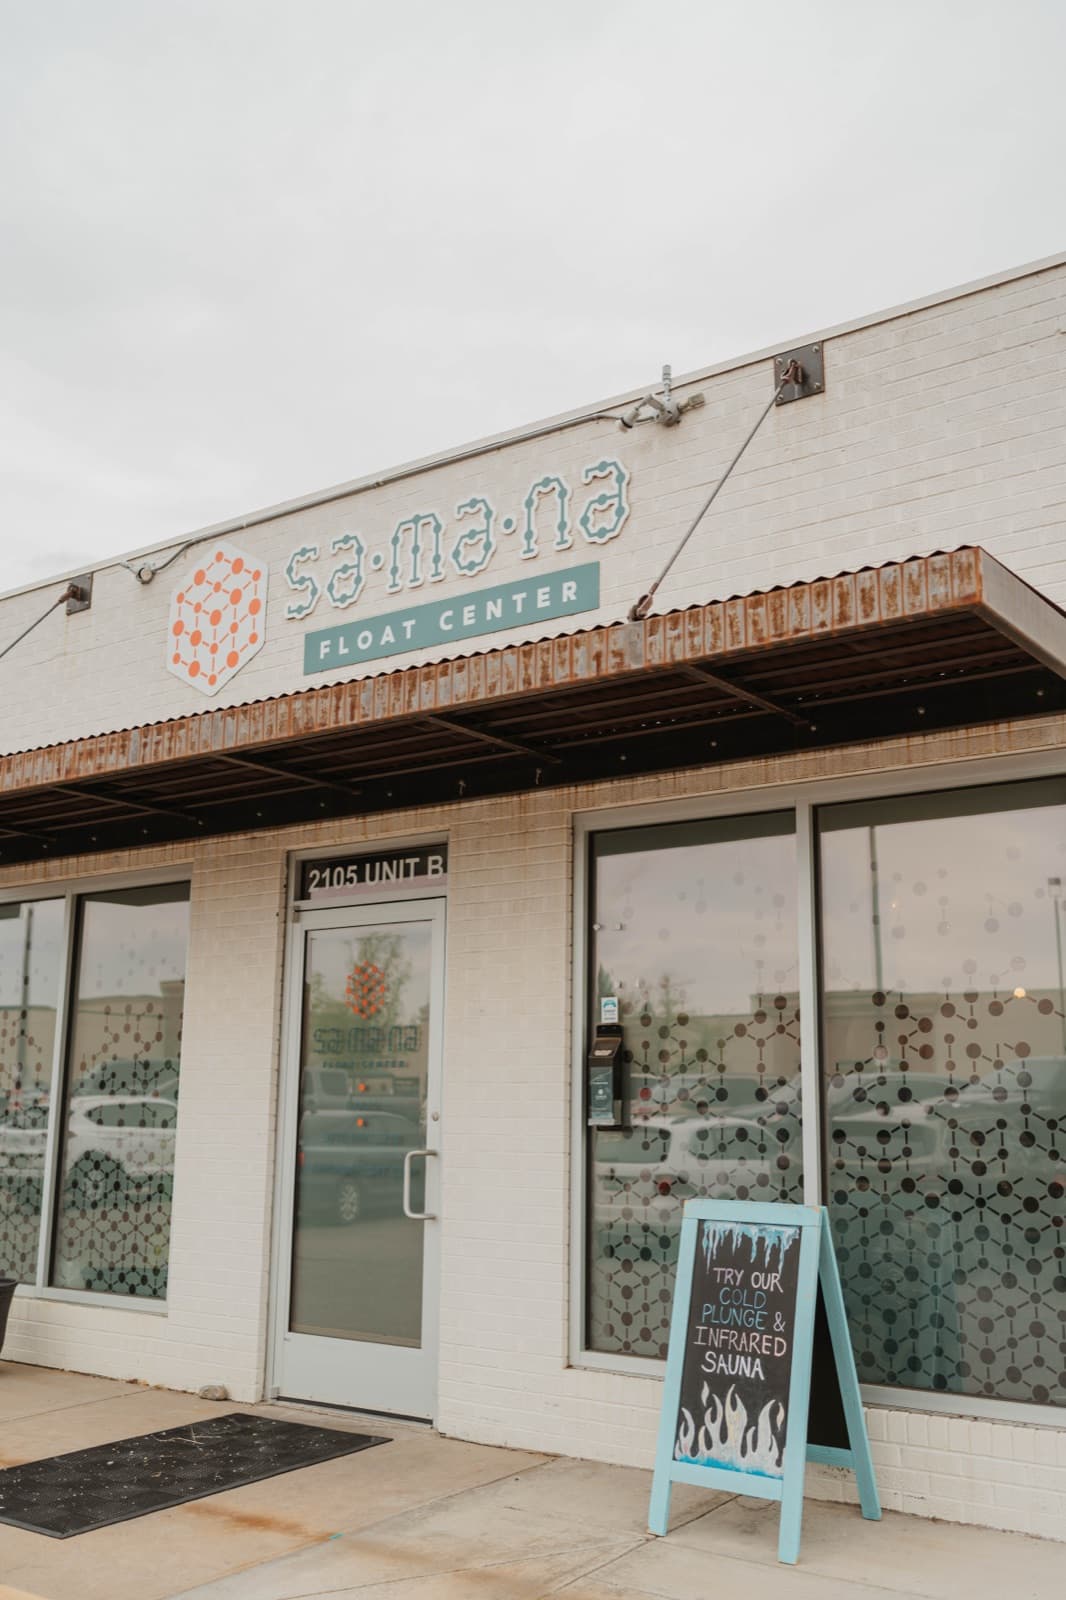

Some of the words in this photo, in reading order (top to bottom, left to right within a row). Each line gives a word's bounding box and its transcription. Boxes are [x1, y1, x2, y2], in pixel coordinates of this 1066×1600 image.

[318, 620, 417, 660] FLOAT
[438, 580, 578, 631] CENTER
[308, 865, 358, 893] 2105
[364, 857, 420, 887] UNIT
[427, 855, 444, 880] B
[712, 1267, 745, 1286] TRY
[750, 1271, 784, 1293] OUR
[719, 1287, 767, 1309] COLD
[701, 1303, 768, 1330] PLUNGE
[773, 1311, 786, 1332] &
[693, 1326, 787, 1357] INFRARED
[701, 1351, 765, 1380] SAUNA
